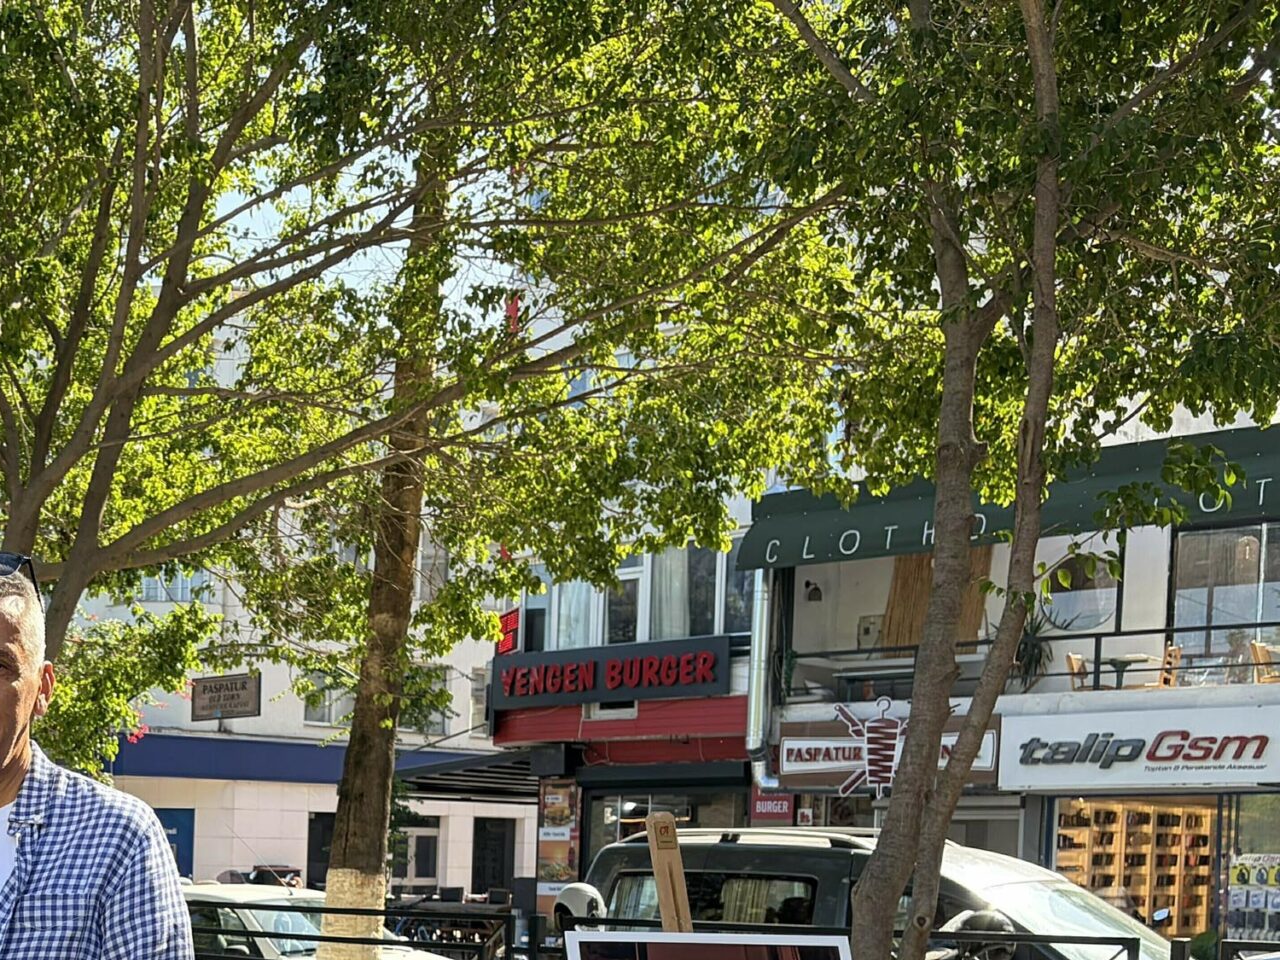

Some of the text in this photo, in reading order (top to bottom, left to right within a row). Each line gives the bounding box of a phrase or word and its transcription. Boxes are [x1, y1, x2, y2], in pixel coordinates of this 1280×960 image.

[499, 650, 716, 699] YENGEN BURGER
[202, 680, 248, 695] PASPATUR
[785, 745, 863, 763] PASPATUR
[756, 800, 789, 813] BURGER
